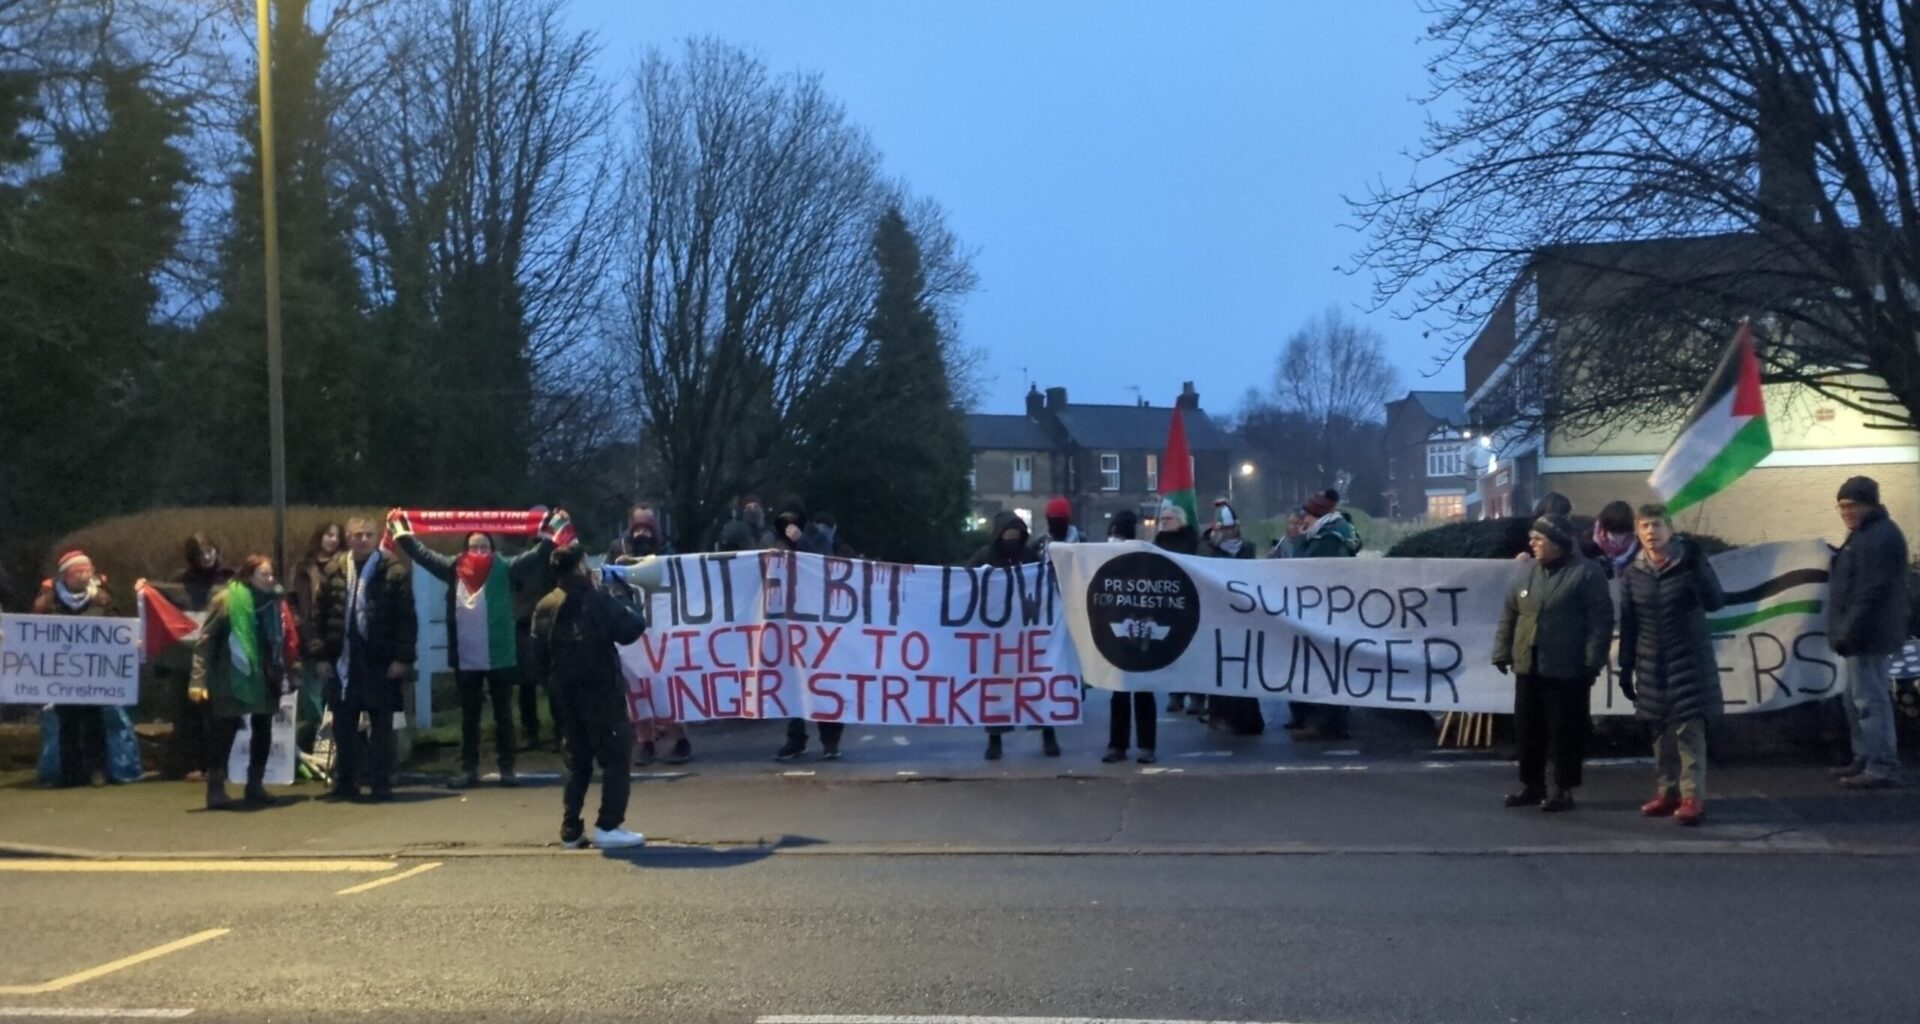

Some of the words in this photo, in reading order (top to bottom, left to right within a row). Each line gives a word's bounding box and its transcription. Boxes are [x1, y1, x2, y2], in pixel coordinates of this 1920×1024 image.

[420, 510, 455, 519] FREE
[457, 510, 530, 519] PALESTINE
[634, 553, 737, 628] HUT
[759, 550, 915, 625] ELBIT
[1104, 578, 1180, 593] PRSONERS
[1093, 593, 1114, 606] FOR
[1115, 594, 1186, 609] PALESTNE
[1226, 580, 1468, 629] SUPPORT
[15, 621, 132, 645] THINKING
[641, 622, 842, 673] VICTORY
[862, 628, 930, 671] TO
[954, 629, 1053, 675] THE
[2, 650, 134, 678] PALESTINE
[1215, 628, 1463, 704] HUNGER
[15, 682, 41, 696] this
[46, 681, 126, 698] Christmas
[626, 669, 789, 725] HUNGER
[808, 672, 1080, 726] STRIKERS
